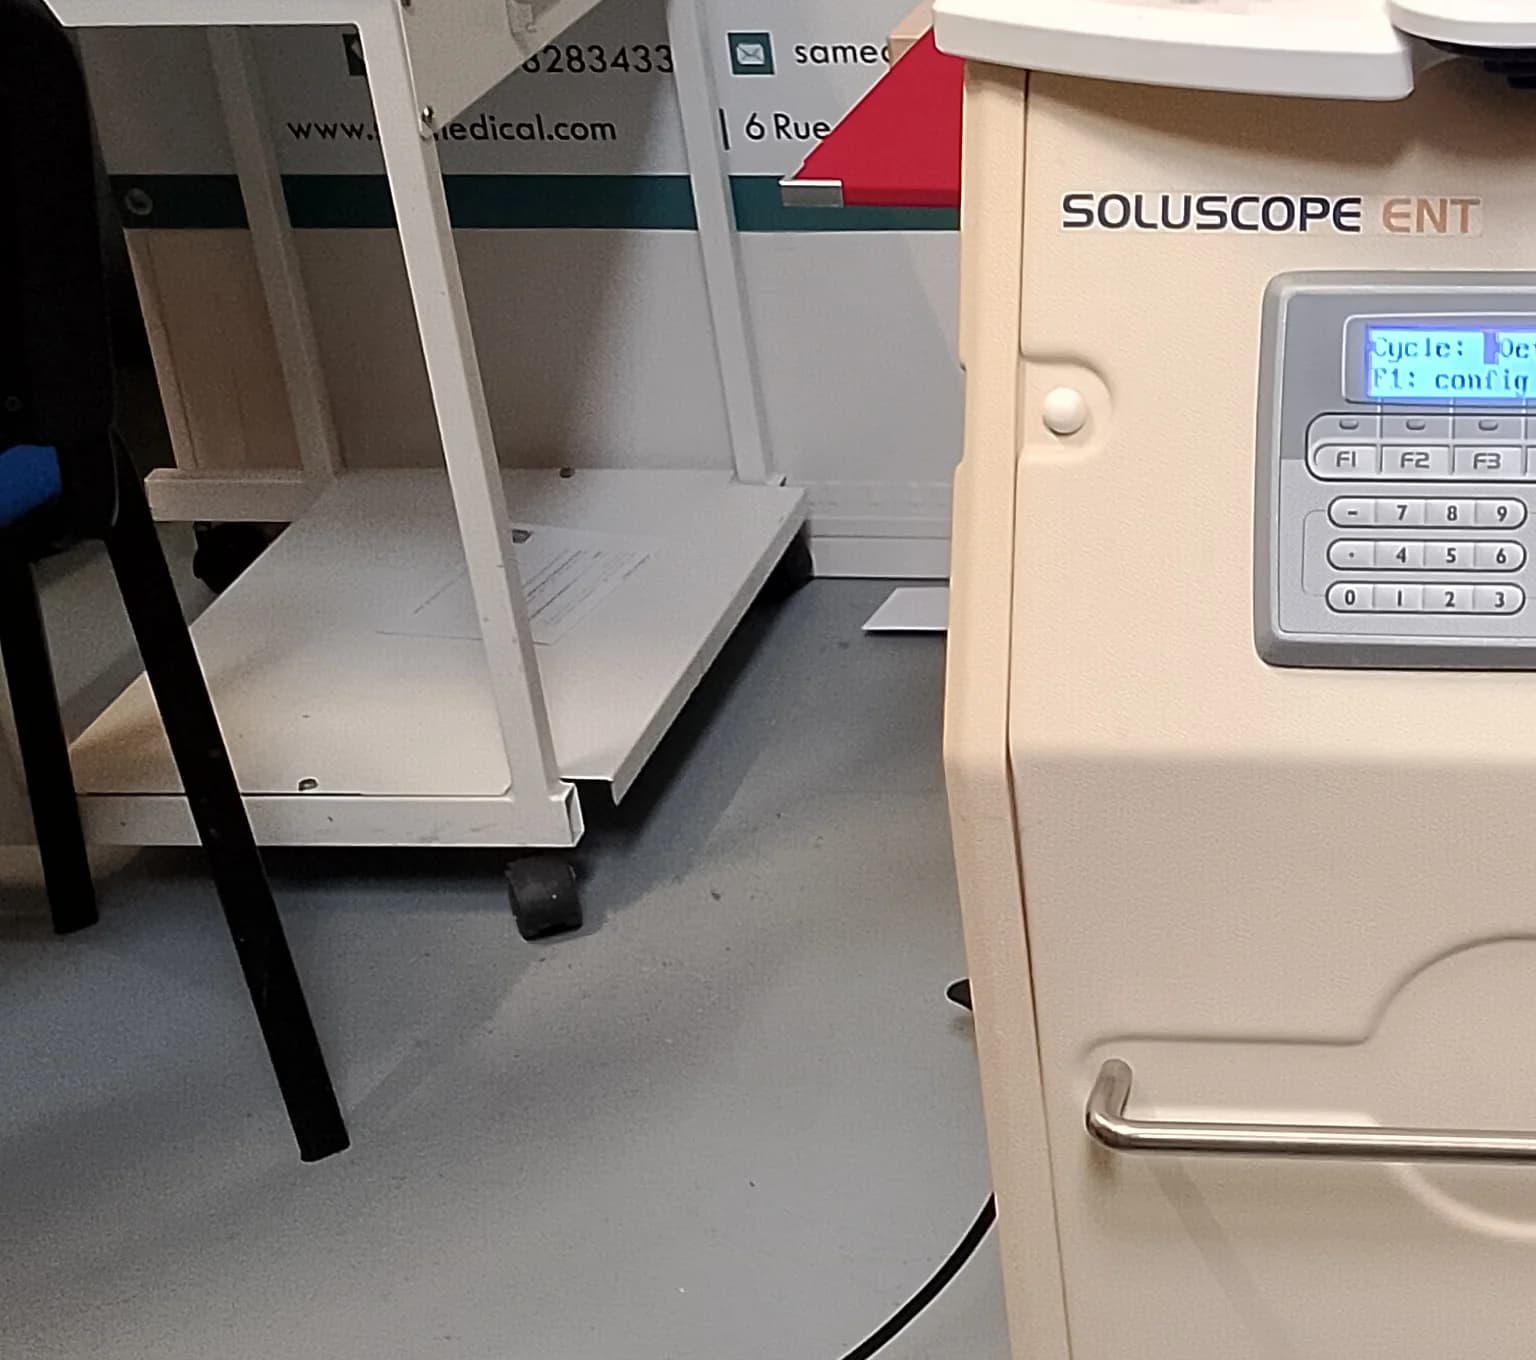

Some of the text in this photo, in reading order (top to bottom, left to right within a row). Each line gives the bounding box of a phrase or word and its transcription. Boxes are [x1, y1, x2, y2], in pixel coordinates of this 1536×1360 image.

[745, 113, 765, 140] 6
[774, 113, 831, 140] Rue
[1062, 194, 1480, 233] SOLUSCOPE ENT
[1374, 337, 1465, 363] Cycle:
[1434, 369, 1529, 397] config
[1336, 451, 1358, 468] F1
[1400, 452, 1431, 469] F2
[1473, 453, 1502, 470] F3
[1397, 506, 1408, 521] 7
[1446, 506, 1458, 522] 8
[1496, 506, 1507, 522] 9
[1395, 548, 1407, 563] 4
[1446, 549, 1456, 564] 5
[1495, 549, 1507, 564] 6
[1344, 590, 1356, 606] 0
[1444, 592, 1456, 607] 2
[1494, 592, 1505, 608] 3
